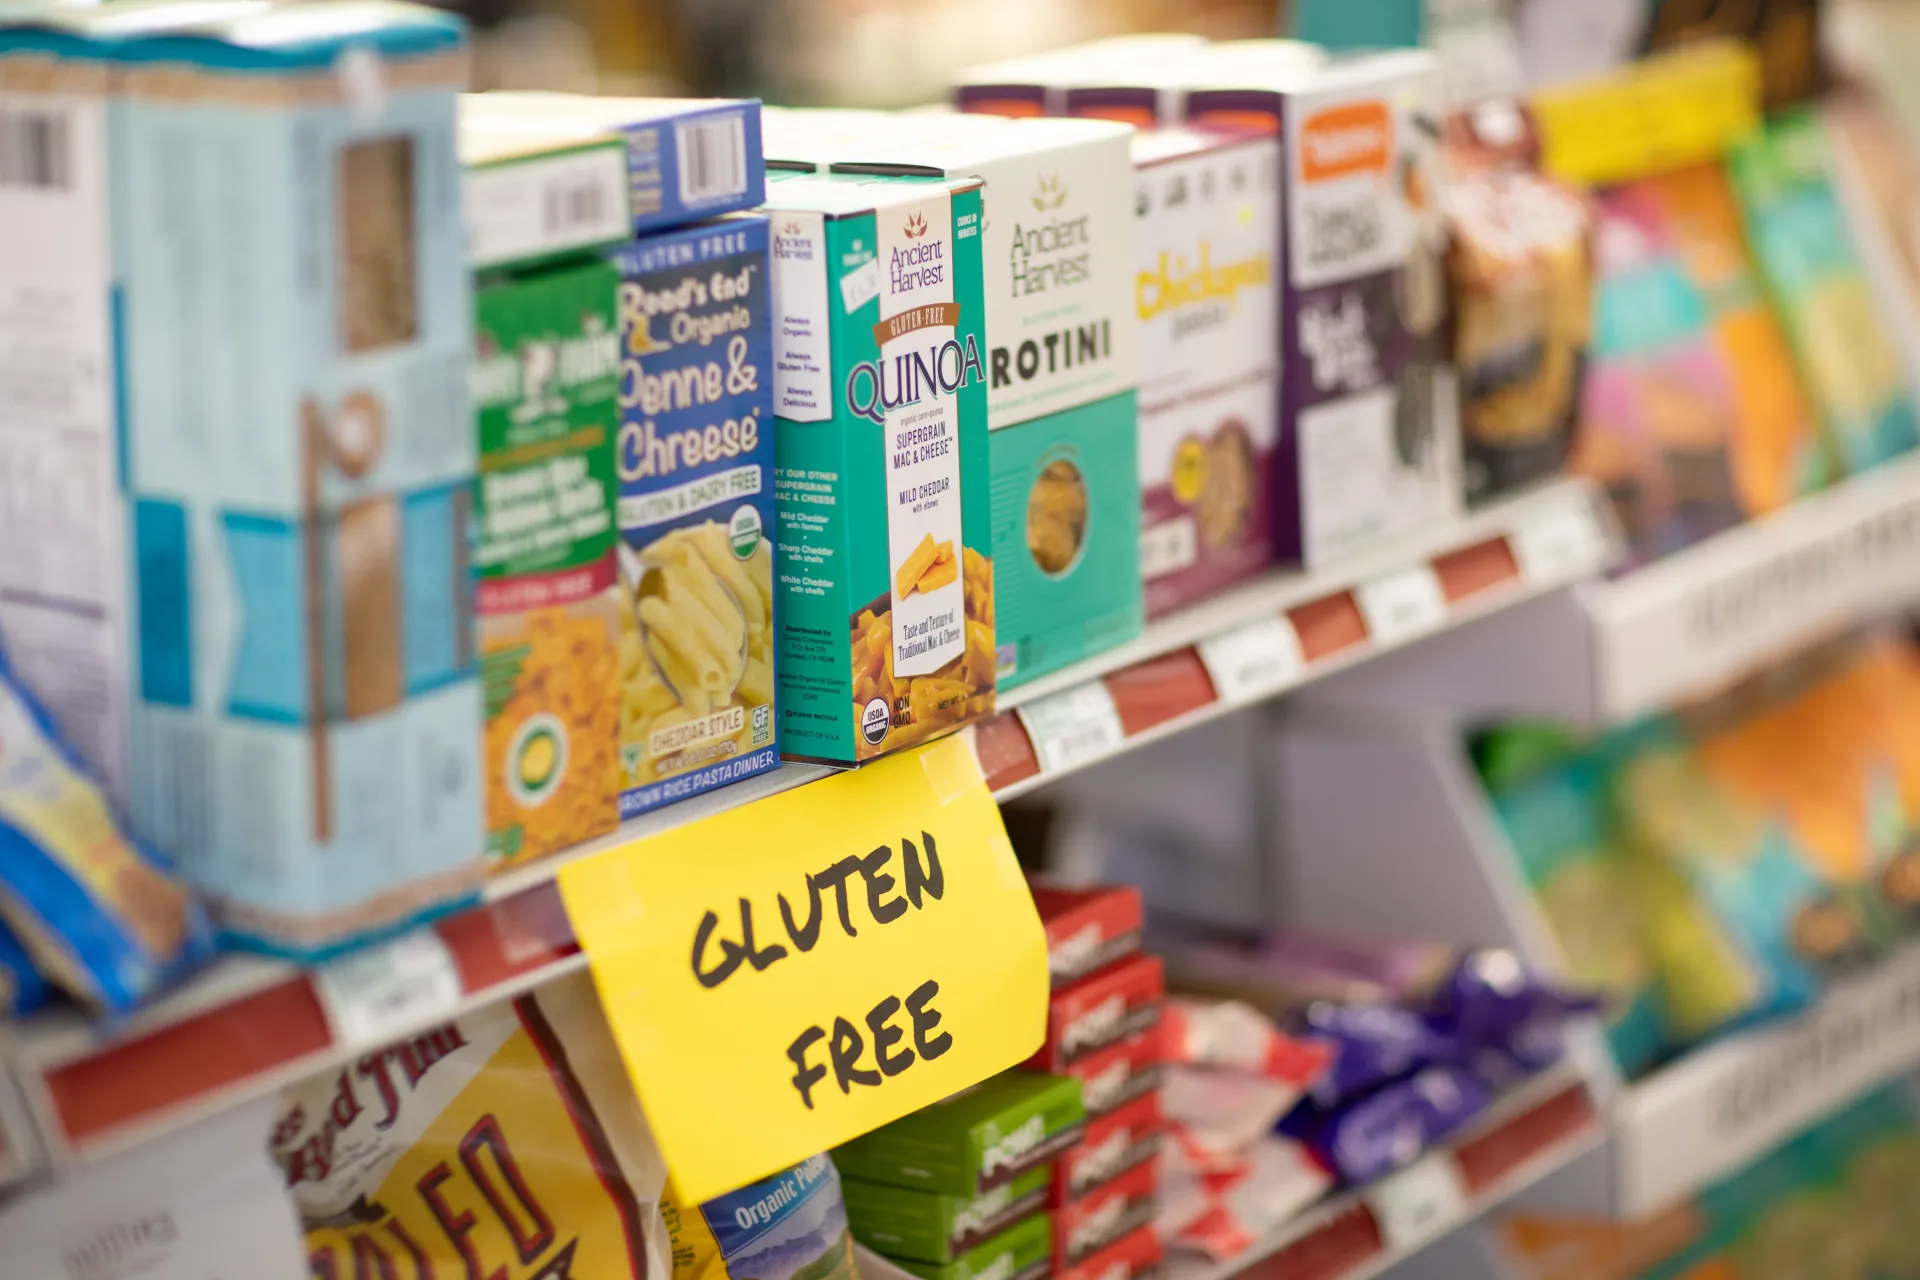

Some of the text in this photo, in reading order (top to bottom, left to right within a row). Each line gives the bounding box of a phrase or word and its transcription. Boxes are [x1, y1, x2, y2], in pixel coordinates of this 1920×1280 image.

[700, 231, 747, 259] FREE
[1011, 213, 1090, 260] Ancient
[890, 240, 943, 272] Ancient
[710, 266, 750, 301] End
[890, 263, 944, 295] Harvest
[1011, 253, 1091, 298] Harvest
[671, 304, 750, 345] Organic
[783, 327, 812, 338] Organic
[784, 316, 810, 326] Always
[890, 306, 945, 338] GLUTEN-FREE
[786, 352, 812, 362] Always
[991, 317, 1112, 390] ROTINI
[618, 358, 722, 415] Penne
[727, 335, 757, 395] &
[777, 361, 820, 373] Gluten Free
[847, 333, 985, 424] QUINOA
[782, 398, 817, 409] Delicious
[787, 387, 812, 398] Always
[900, 413, 917, 427] organic
[896, 420, 946, 450] SUPERGRAIN
[616, 415, 760, 482] Chreese
[893, 450, 911, 470] MAC
[913, 450, 919, 464] &
[775, 480, 832, 493] SUPERGRAIN
[786, 469, 806, 479] OUR
[807, 471, 838, 482] OTHER
[690, 481, 729, 506] DAIRY
[730, 469, 759, 492] FREE
[899, 477, 950, 505] MILD CHEDDAR
[801, 494, 837, 505] CHEESE
[912, 499, 939, 514] with elbows
[780, 512, 829, 523] Mild Cheddar
[778, 543, 834, 556] Sharp Cheddar
[780, 575, 834, 588] White Cheddar
[785, 625, 822, 636] Distributed
[903, 607, 954, 641] Taste and Texture of
[898, 628, 960, 662] Traditional Mac & Cheese
[867, 708, 884, 721] USDA
[893, 694, 910, 713] NON
[709, 709, 741, 736] STYLE
[753, 705, 769, 728] GF
[793, 711, 838, 721] PLEASE RECYCLE
[865, 720, 888, 735] ORGANIC
[893, 711, 911, 729] GMO
[784, 728, 814, 738] PRODUCT
[663, 778, 692, 801] RICE
[693, 764, 732, 791] PASTA
[733, 750, 774, 777] DINNER
[690, 829, 944, 989] GLUTEN
[785, 979, 954, 1110] FREE
[734, 1179, 799, 1231] Organic
